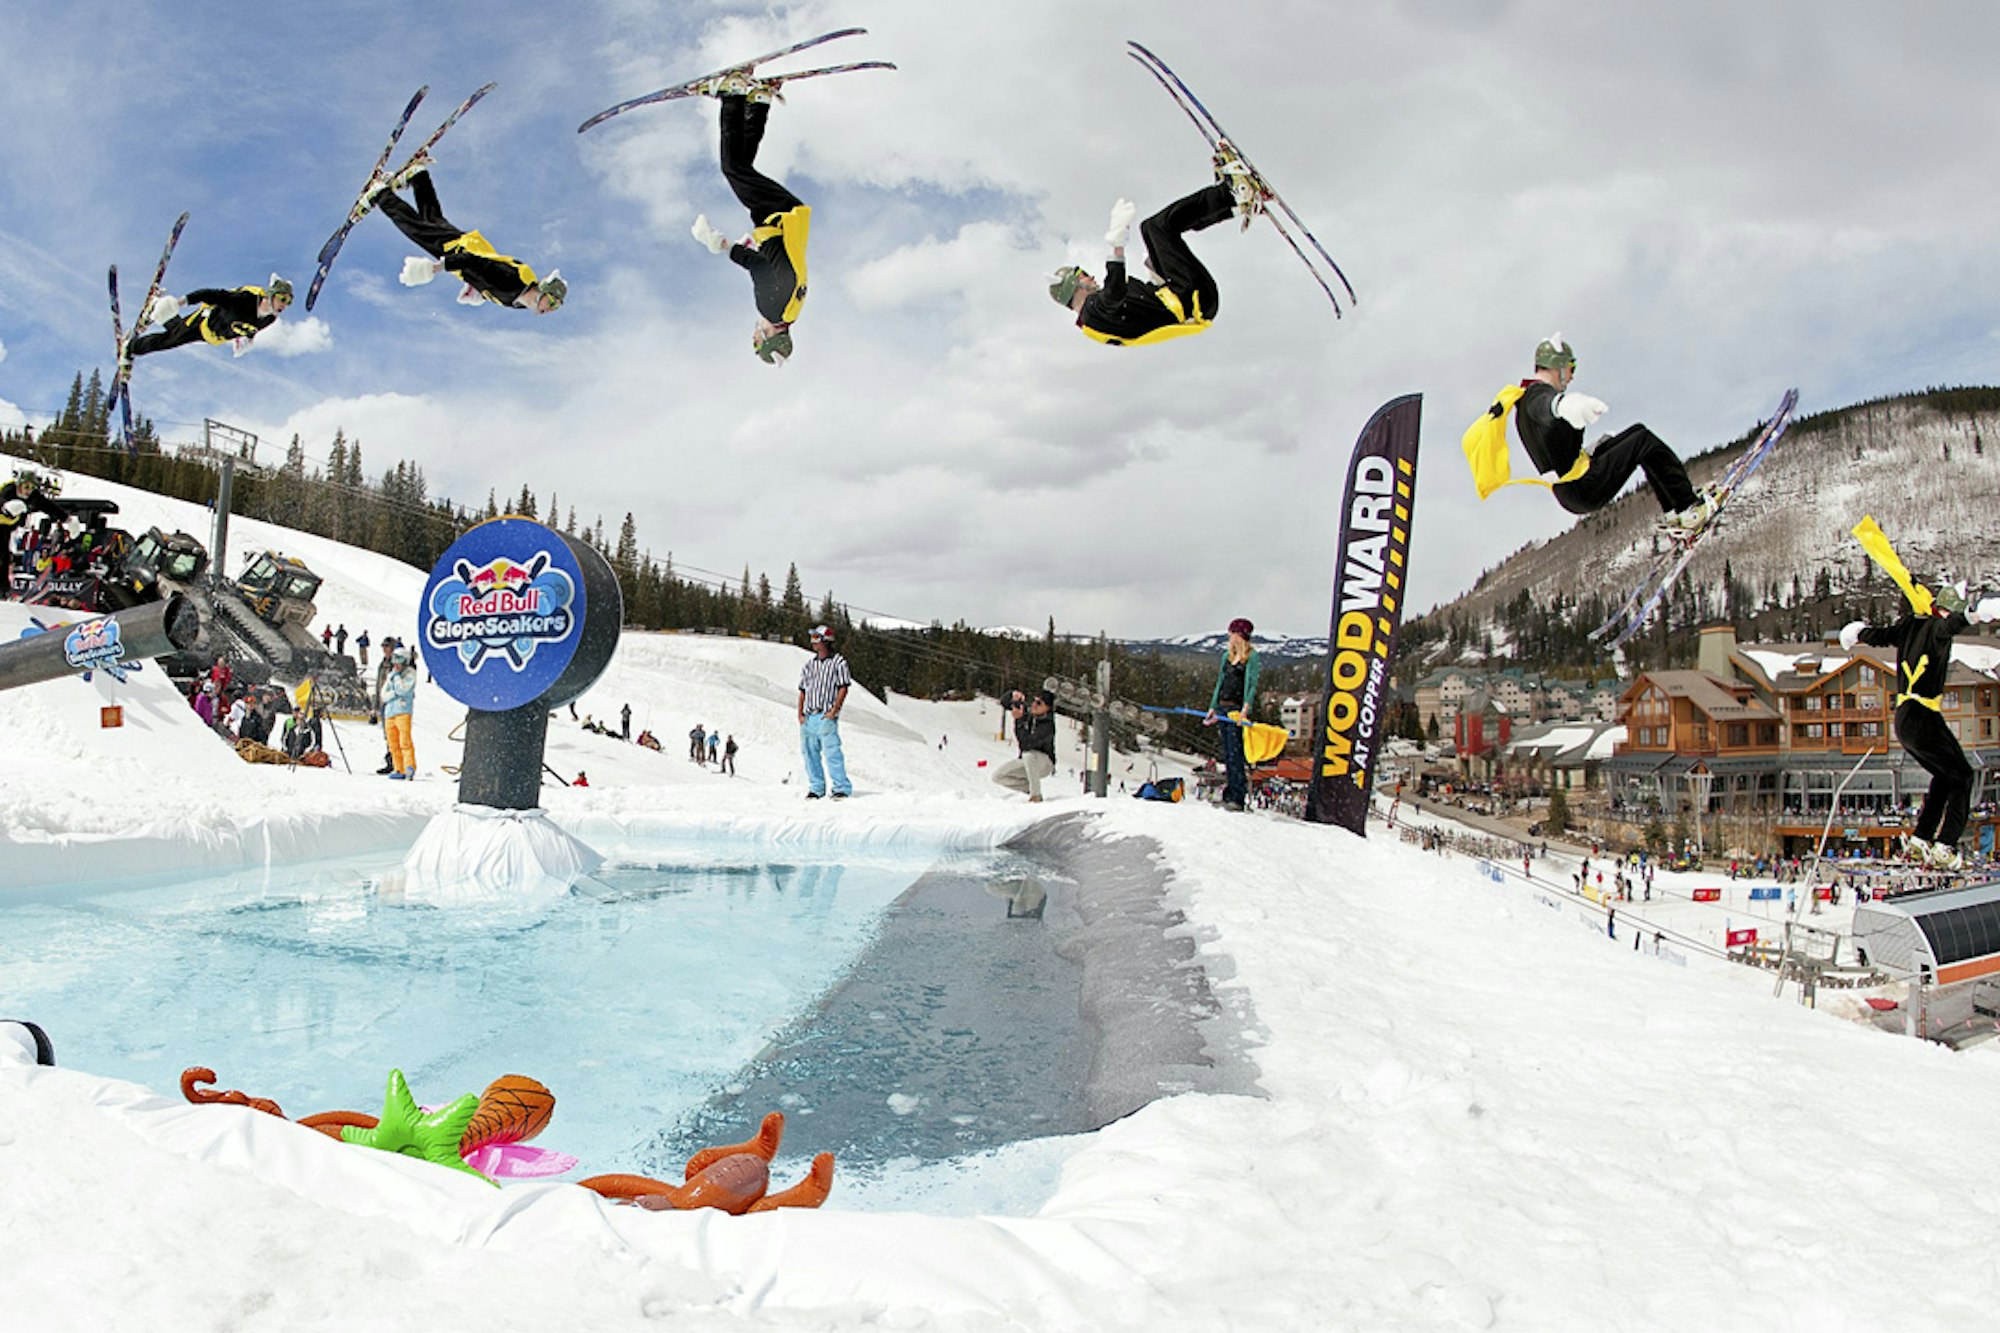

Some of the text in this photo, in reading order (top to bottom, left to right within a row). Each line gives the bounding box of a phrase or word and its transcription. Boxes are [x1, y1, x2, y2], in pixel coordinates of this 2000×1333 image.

[433, 615, 566, 640] SlopeSoakers
[459, 589, 539, 615] Red Bull
[1323, 455, 1396, 779] WOODWARD
[1353, 658, 1386, 768] AT COPPER
